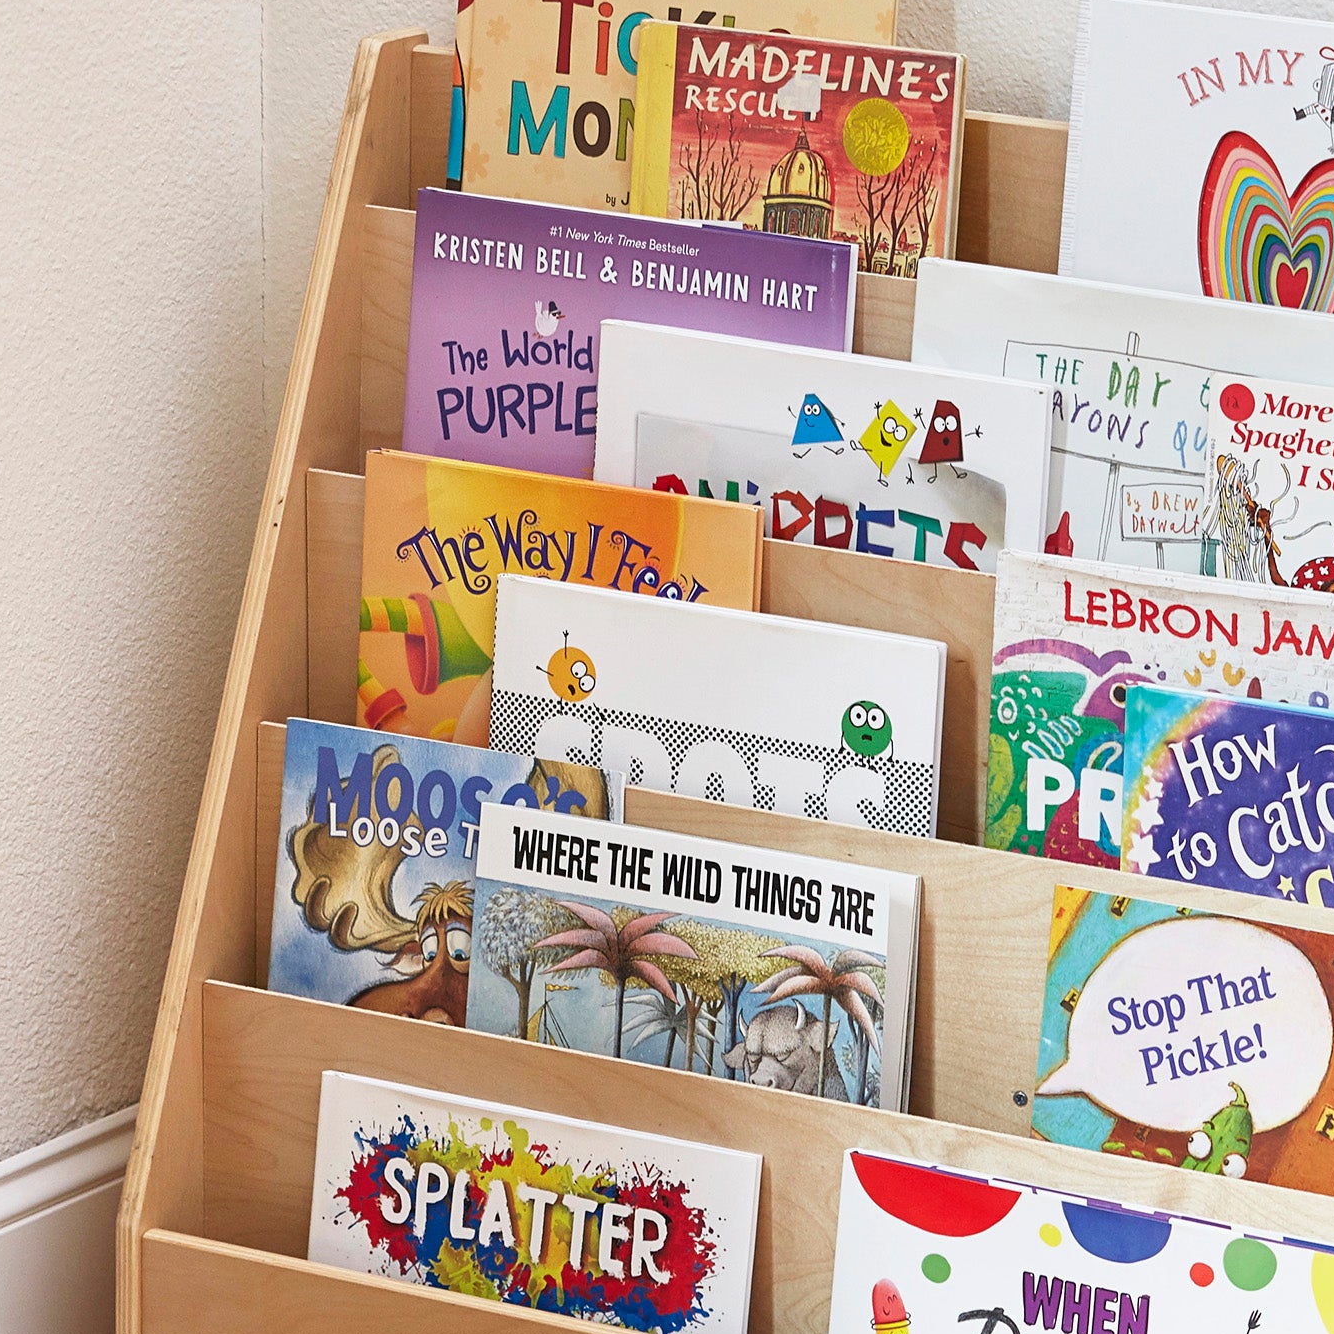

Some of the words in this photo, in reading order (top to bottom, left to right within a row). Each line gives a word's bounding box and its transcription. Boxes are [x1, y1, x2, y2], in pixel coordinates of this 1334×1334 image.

[687, 36, 952, 103] MADELINE'S
[1177, 57, 1227, 107] IN
[1234, 48, 1305, 87] MY
[605, 193, 617, 207] by
[549, 226, 563, 238] #1
[566, 227, 590, 242] New
[593, 230, 614, 245] York
[617, 234, 647, 250] Times
[649, 238, 700, 257] Bestseller
[433, 232, 524, 271] KRISTEN
[536, 248, 587, 280] BELL
[599, 258, 618, 285] &
[631, 259, 749, 304] BENJAMIN
[762, 278, 818, 313] HART
[441, 340, 489, 376] The
[500, 329, 595, 374] World
[1035, 353, 1084, 385] THE
[1106, 361, 1172, 409] DAY
[436, 382, 597, 441] PURPLE
[1260, 392, 1334, 423] More
[1152, 490, 1199, 512] DREW
[1297, 465, 1311, 487] I
[396, 524, 492, 596] The
[483, 509, 578, 583] Way
[580, 521, 605, 581] I
[1169, 724, 1281, 808] How
[328, 801, 449, 858] Loose
[1166, 828, 1219, 881] to
[513, 826, 601, 884] WHERE
[607, 841, 654, 893] THE
[662, 852, 723, 905] WILD
[731, 864, 823, 925] THINGS
[829, 884, 876, 937] ARE
[1106, 992, 1187, 1036] Stop
[1187, 965, 1278, 1016] That
[1138, 1022, 1269, 1087] Pickle!
[378, 1155, 672, 1285] SPLATTER
